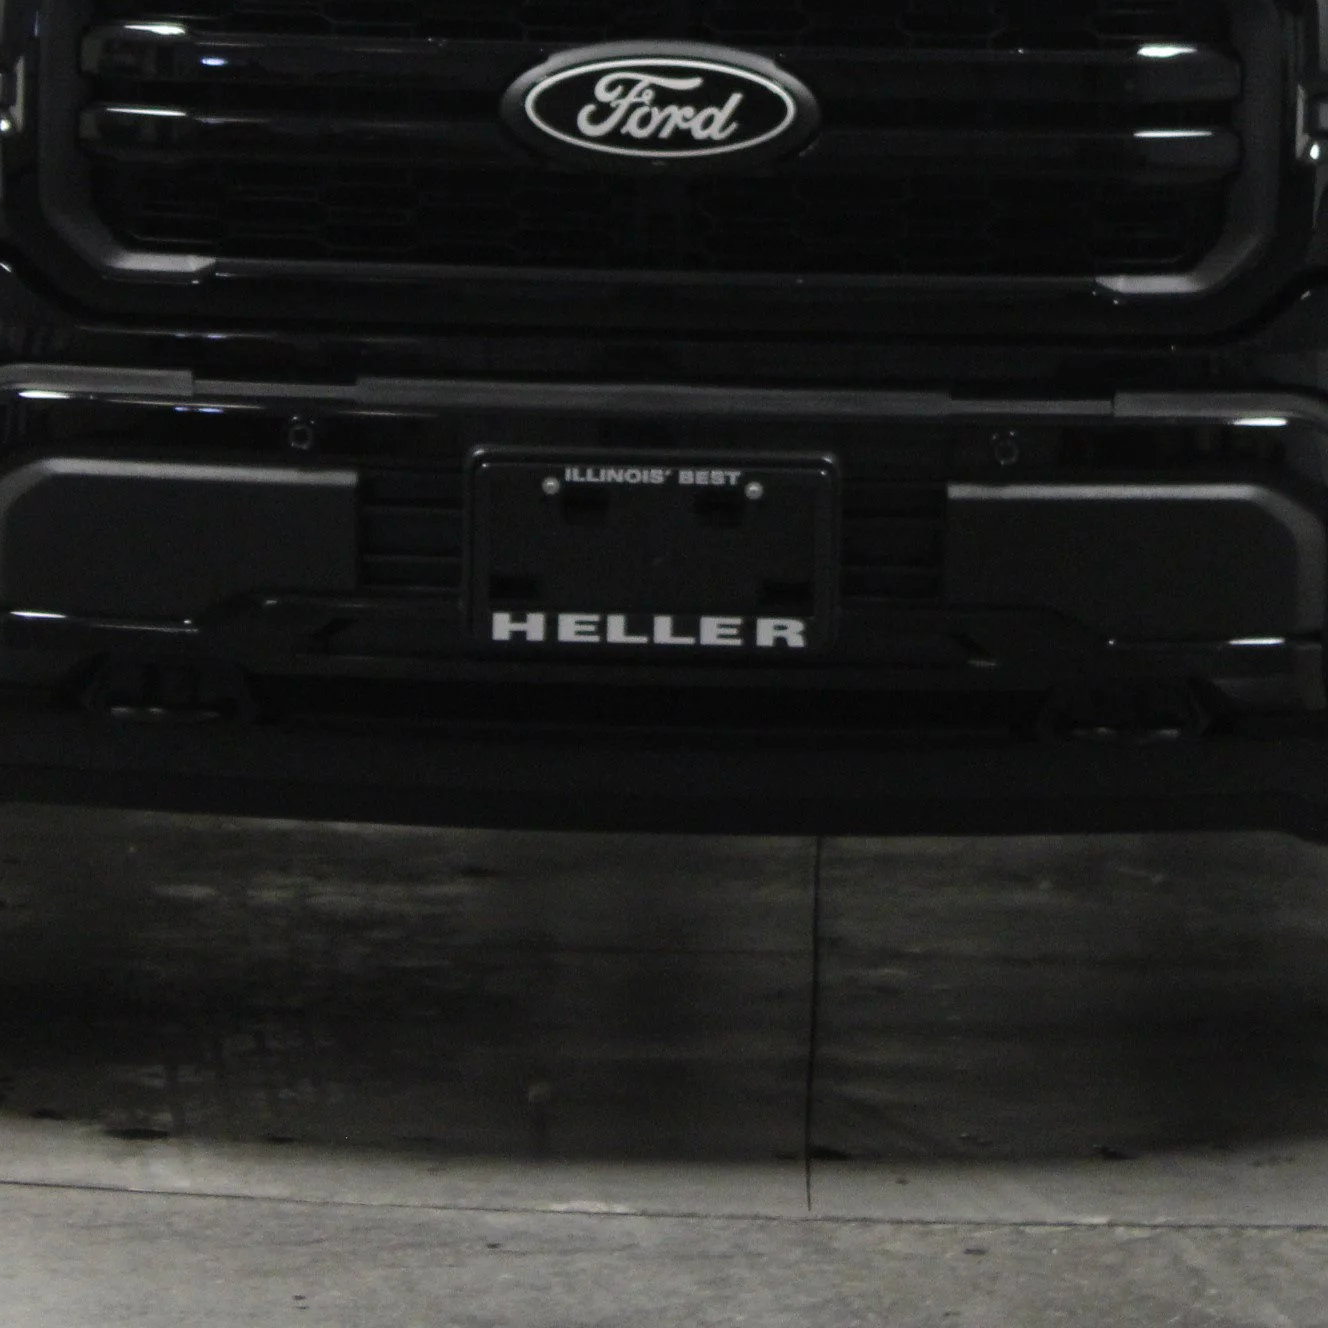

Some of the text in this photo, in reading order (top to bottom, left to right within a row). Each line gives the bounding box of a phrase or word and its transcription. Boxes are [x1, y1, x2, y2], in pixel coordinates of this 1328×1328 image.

[577, 72, 743, 140] Ford
[679, 470, 742, 485] BEST
[492, 612, 806, 647] HELLER
